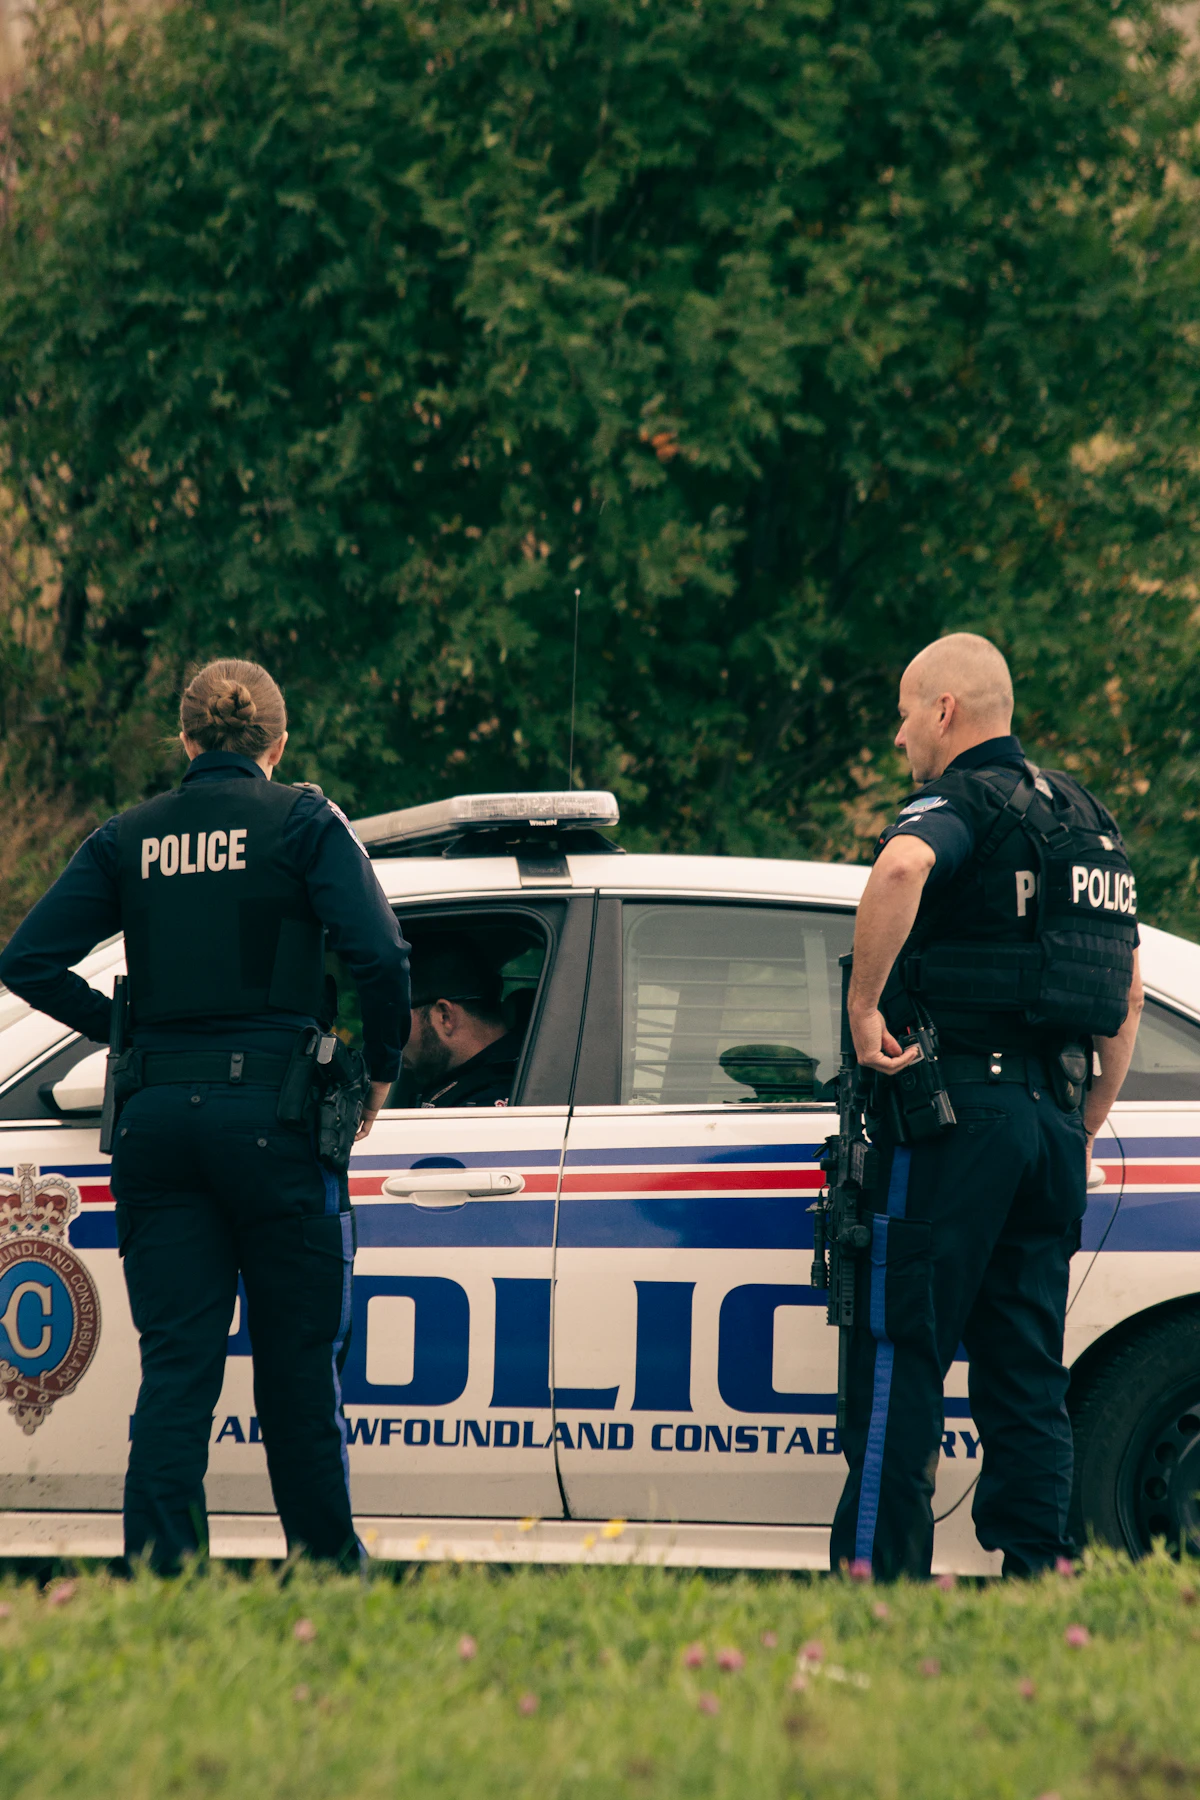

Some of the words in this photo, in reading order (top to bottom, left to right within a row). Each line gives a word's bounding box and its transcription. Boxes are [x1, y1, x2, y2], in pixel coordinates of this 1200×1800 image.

[141, 828, 248, 880] POLICE
[1071, 865, 1137, 915] POLICE
[0, 1242, 74, 1273] UNDLAND
[57, 1273, 94, 1388] CONSTABULARY
[226, 1270, 971, 1418] OLIC
[651, 1424, 981, 1459] CONSTABRY
